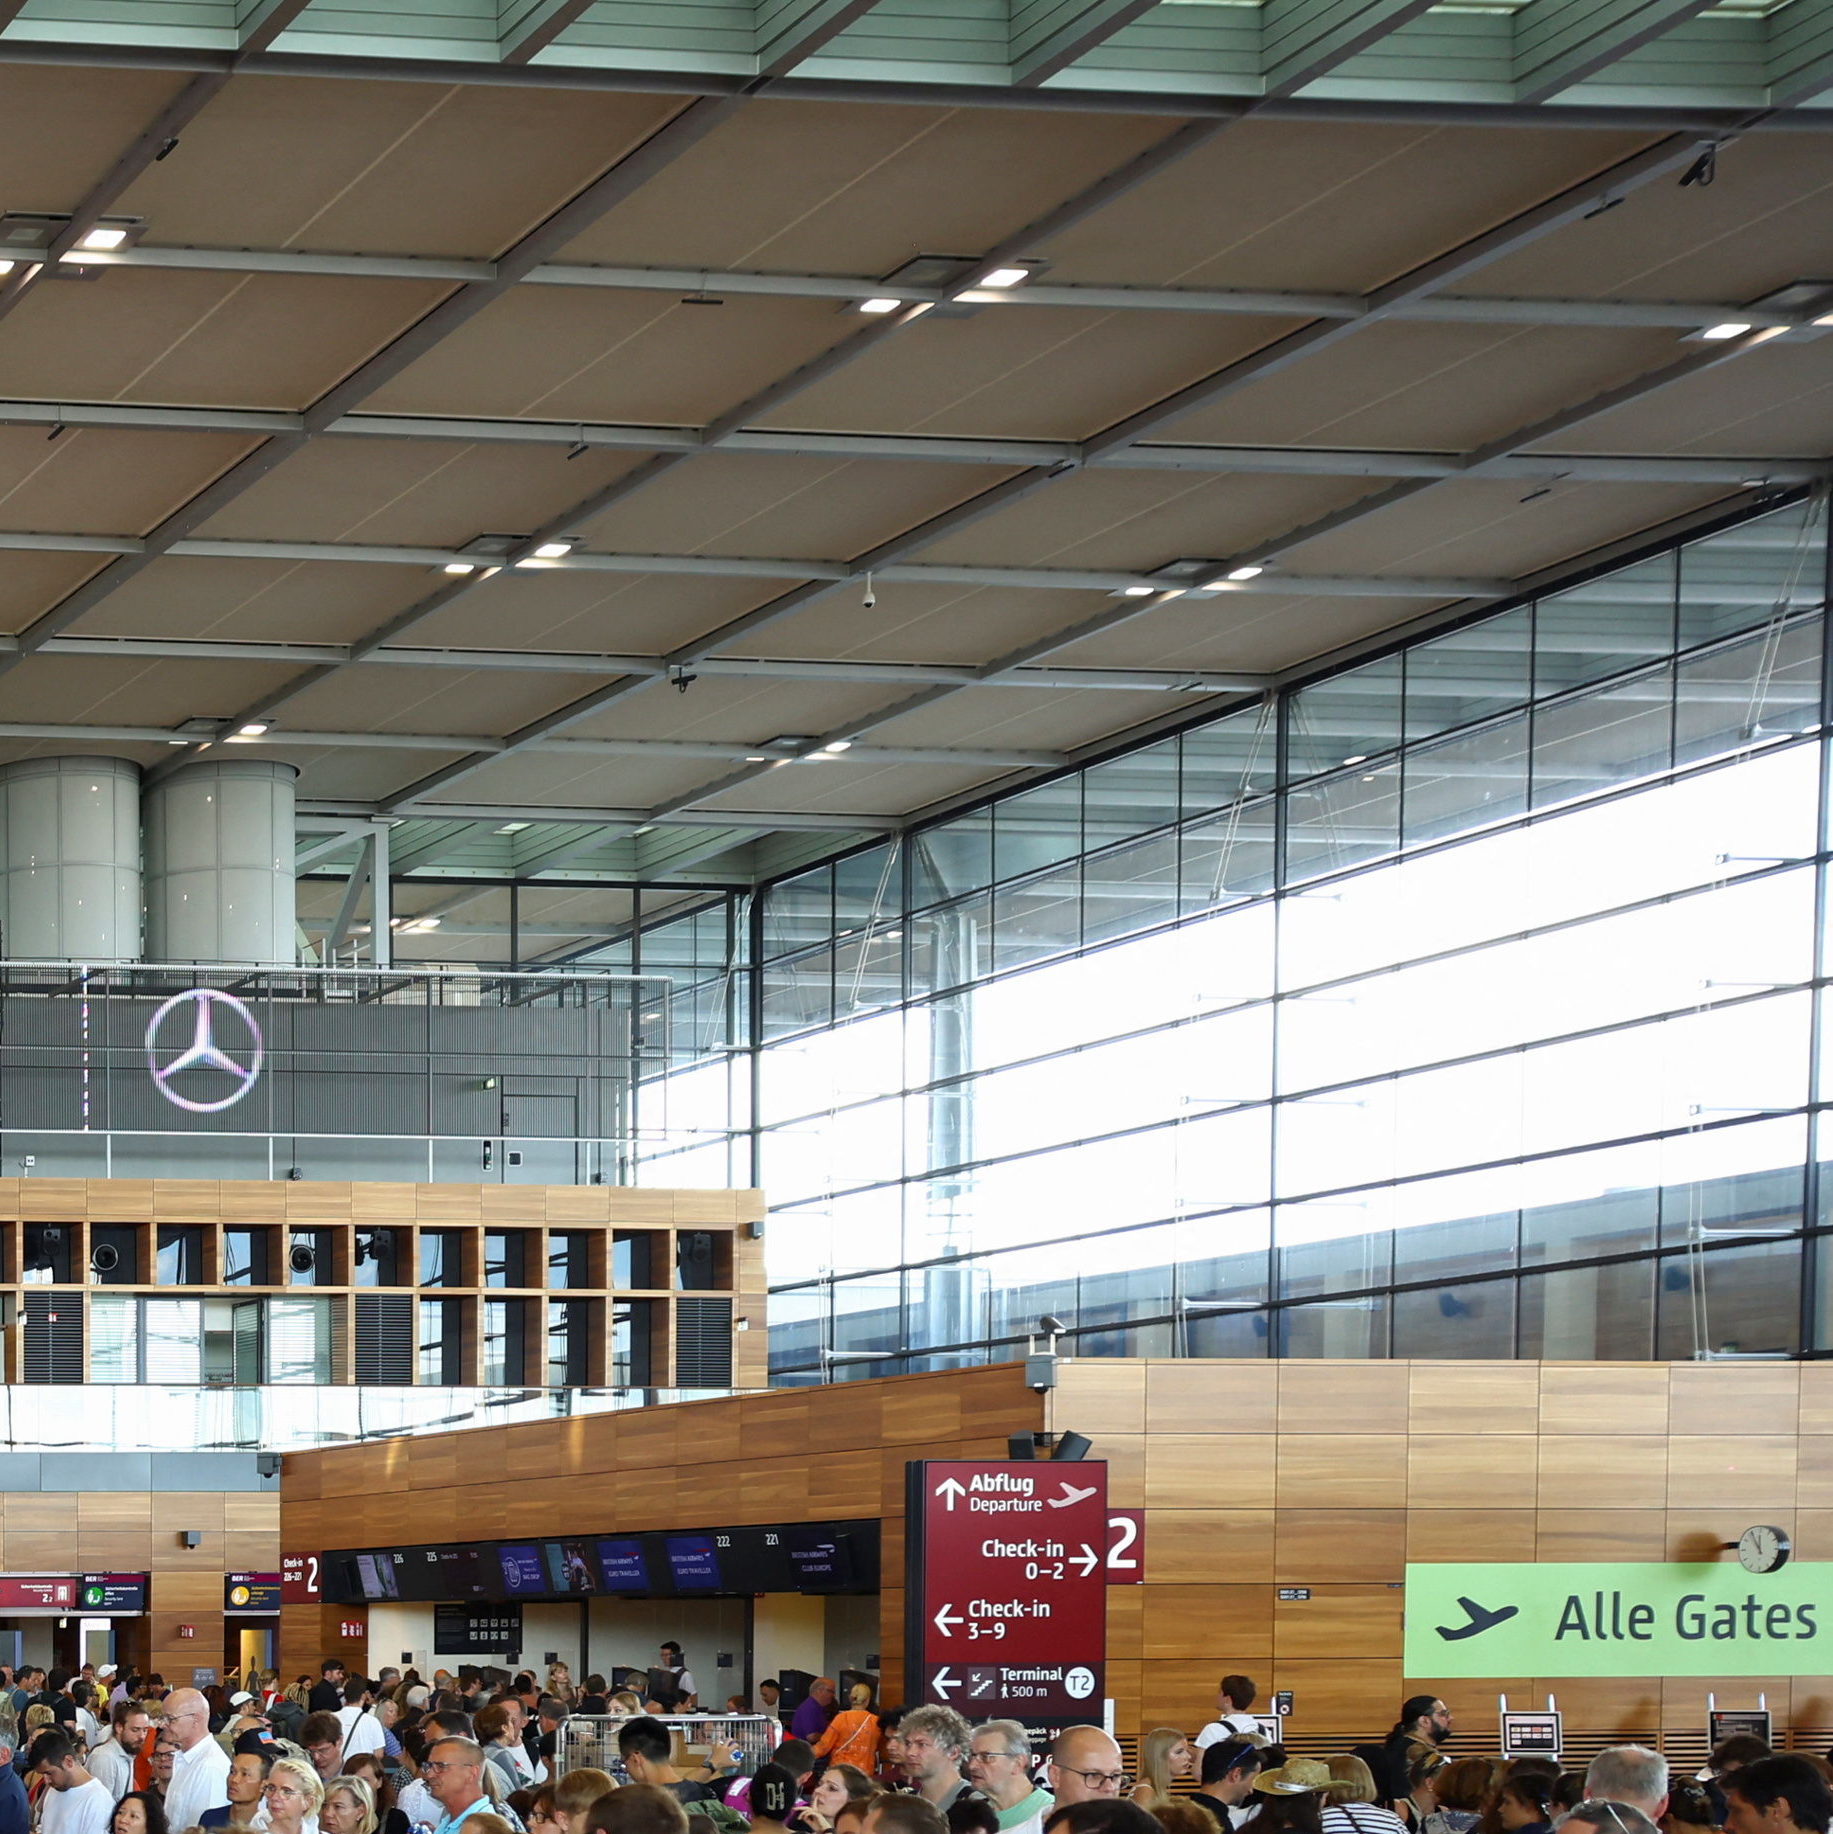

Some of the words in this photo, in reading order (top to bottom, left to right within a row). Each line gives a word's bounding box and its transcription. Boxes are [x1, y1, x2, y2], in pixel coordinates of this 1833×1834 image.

[969, 1473, 1034, 1496] Abflug
[969, 1497, 1043, 1515] Departure
[716, 1535, 731, 1548] 222
[765, 1533, 779, 1546] 221
[982, 1539, 1064, 1558] Check-in
[1106, 1517, 1138, 1569] 2
[283, 1557, 304, 1568] Check-in
[426, 1551, 438, 1562] 225
[307, 1556, 318, 1592] 2
[1025, 1562, 1065, 1580] 0–2
[968, 1599, 1050, 1618] Check-in
[1554, 1591, 1655, 1641] Alle
[1675, 1593, 1818, 1640] Gates
[968, 1622, 1006, 1640] 3–9
[1000, 1667, 1063, 1682] Terminal
[1069, 1675, 1090, 1690] T2
[1012, 1686, 1034, 1698] 500
[1036, 1687, 1048, 1698] m
